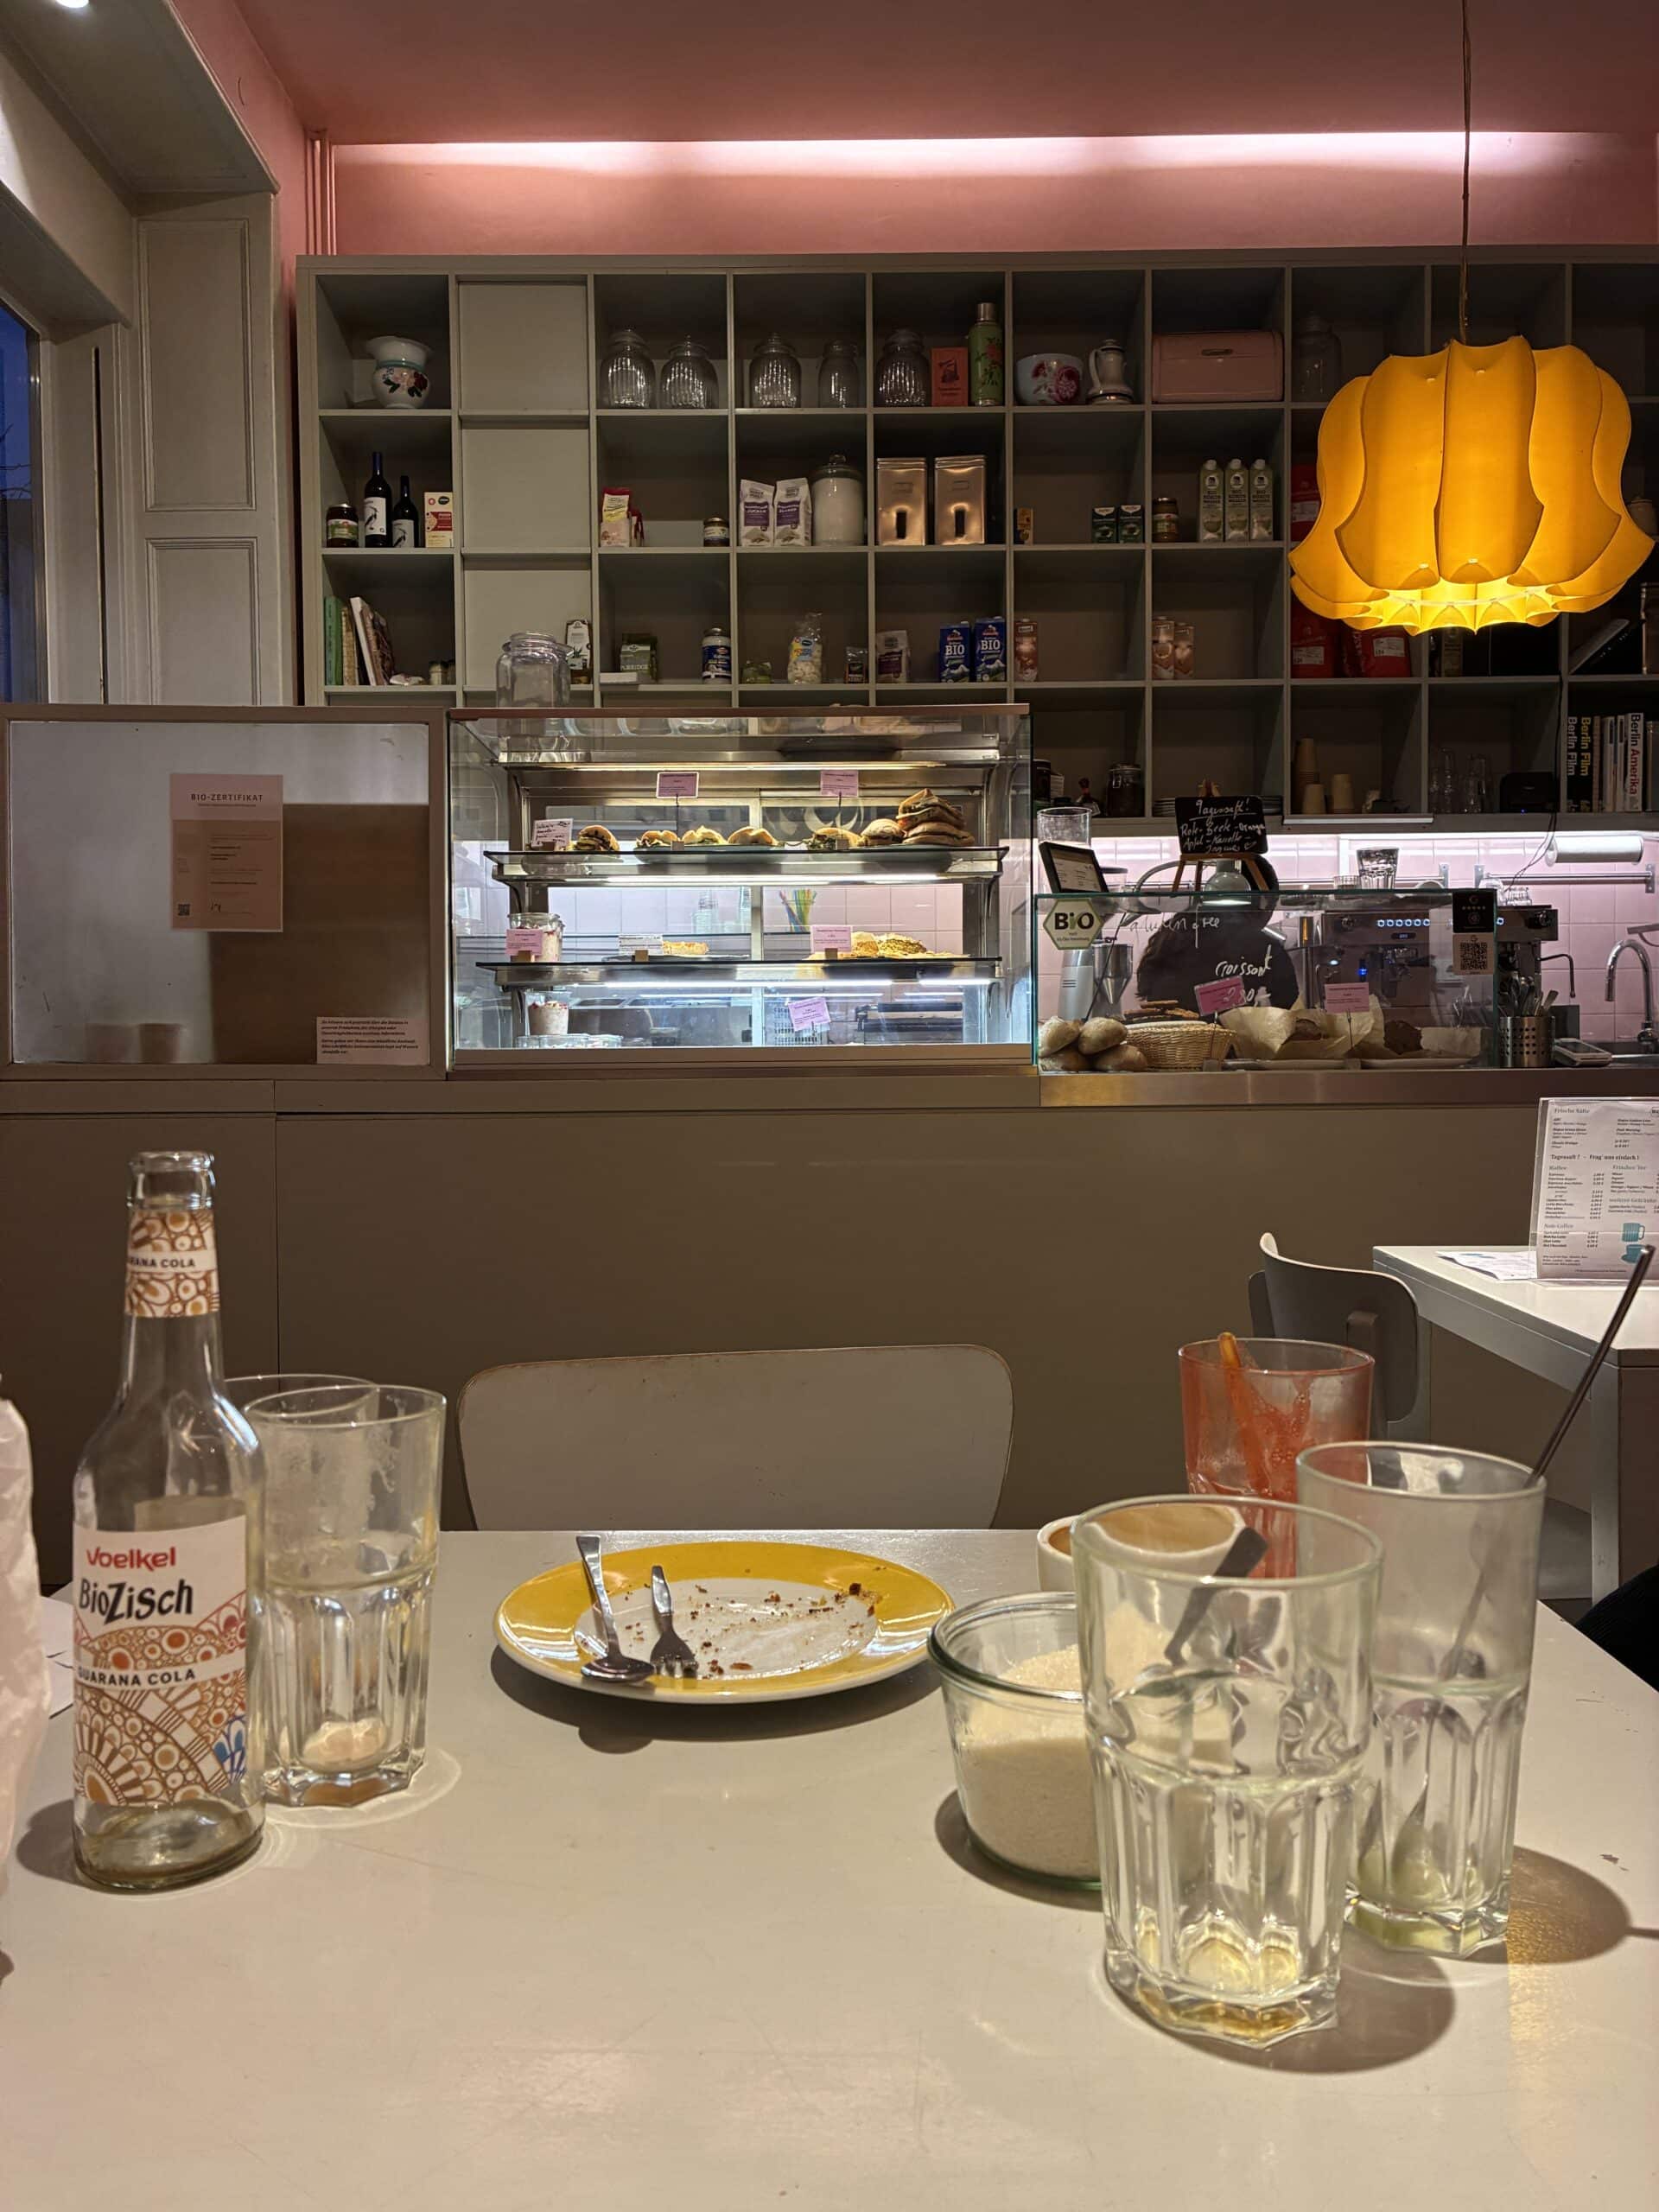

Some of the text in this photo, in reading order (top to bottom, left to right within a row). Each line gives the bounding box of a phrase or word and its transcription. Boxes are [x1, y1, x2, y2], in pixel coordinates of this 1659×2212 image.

[945, 644, 965, 656] BIO
[981, 639, 1001, 651] BIO
[1567, 717, 1578, 776] Berlin Film
[1580, 717, 1591, 776] Berlin Film
[1630, 714, 1641, 795] Berlin Amerika
[190, 793, 264, 802] BIO-ZERTIFIKAT
[160, 1258, 196, 1268] COLA
[86, 1546, 177, 1573] Voelkel
[79, 1577, 194, 1626] BioZisch
[78, 1665, 196, 1687] GUARANA COLA
